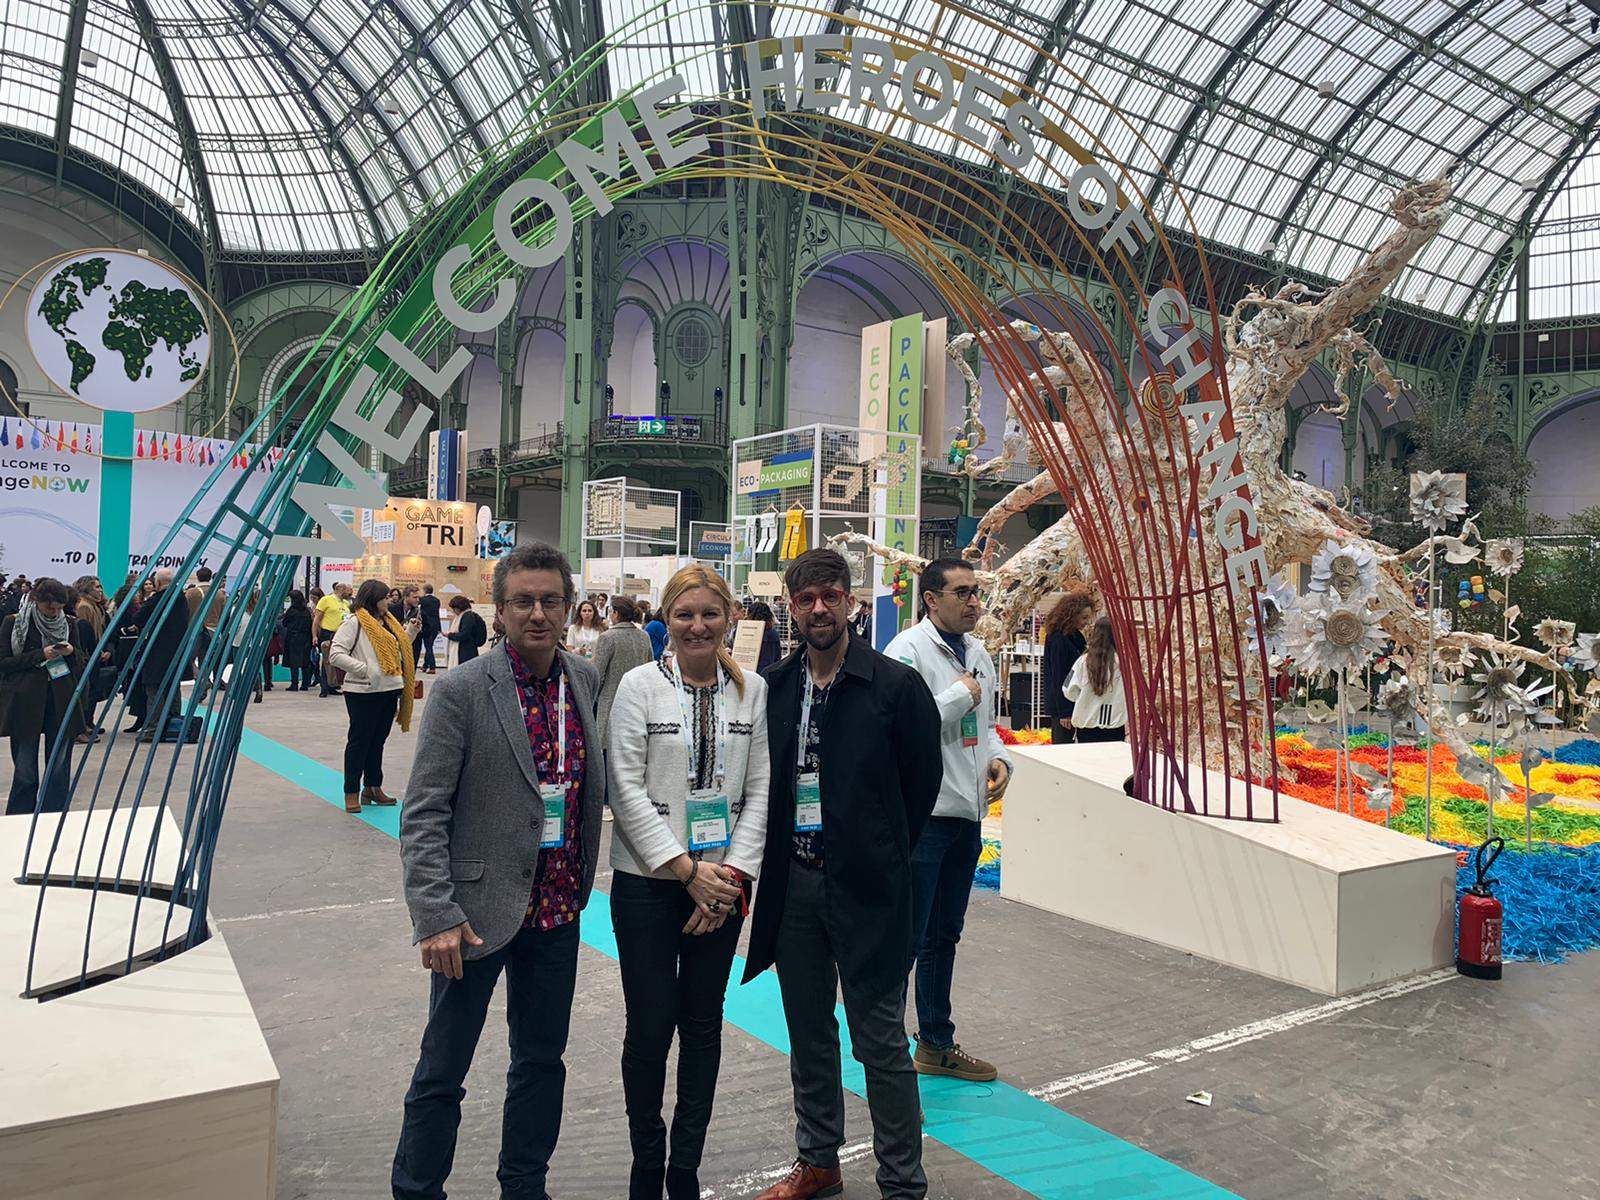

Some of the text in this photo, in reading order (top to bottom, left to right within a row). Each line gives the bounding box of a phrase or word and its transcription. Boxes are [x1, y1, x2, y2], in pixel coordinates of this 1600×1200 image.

[267, 34, 1271, 599] WELCOME HEROES OF CHANGE
[867, 346, 880, 417] ECO
[53, 463, 71, 473] TO
[740, 466, 808, 487] ECO PACKAGING
[405, 505, 464, 525] GAME
[406, 522, 464, 546] OF TRI
[86, 552, 97, 565] D
